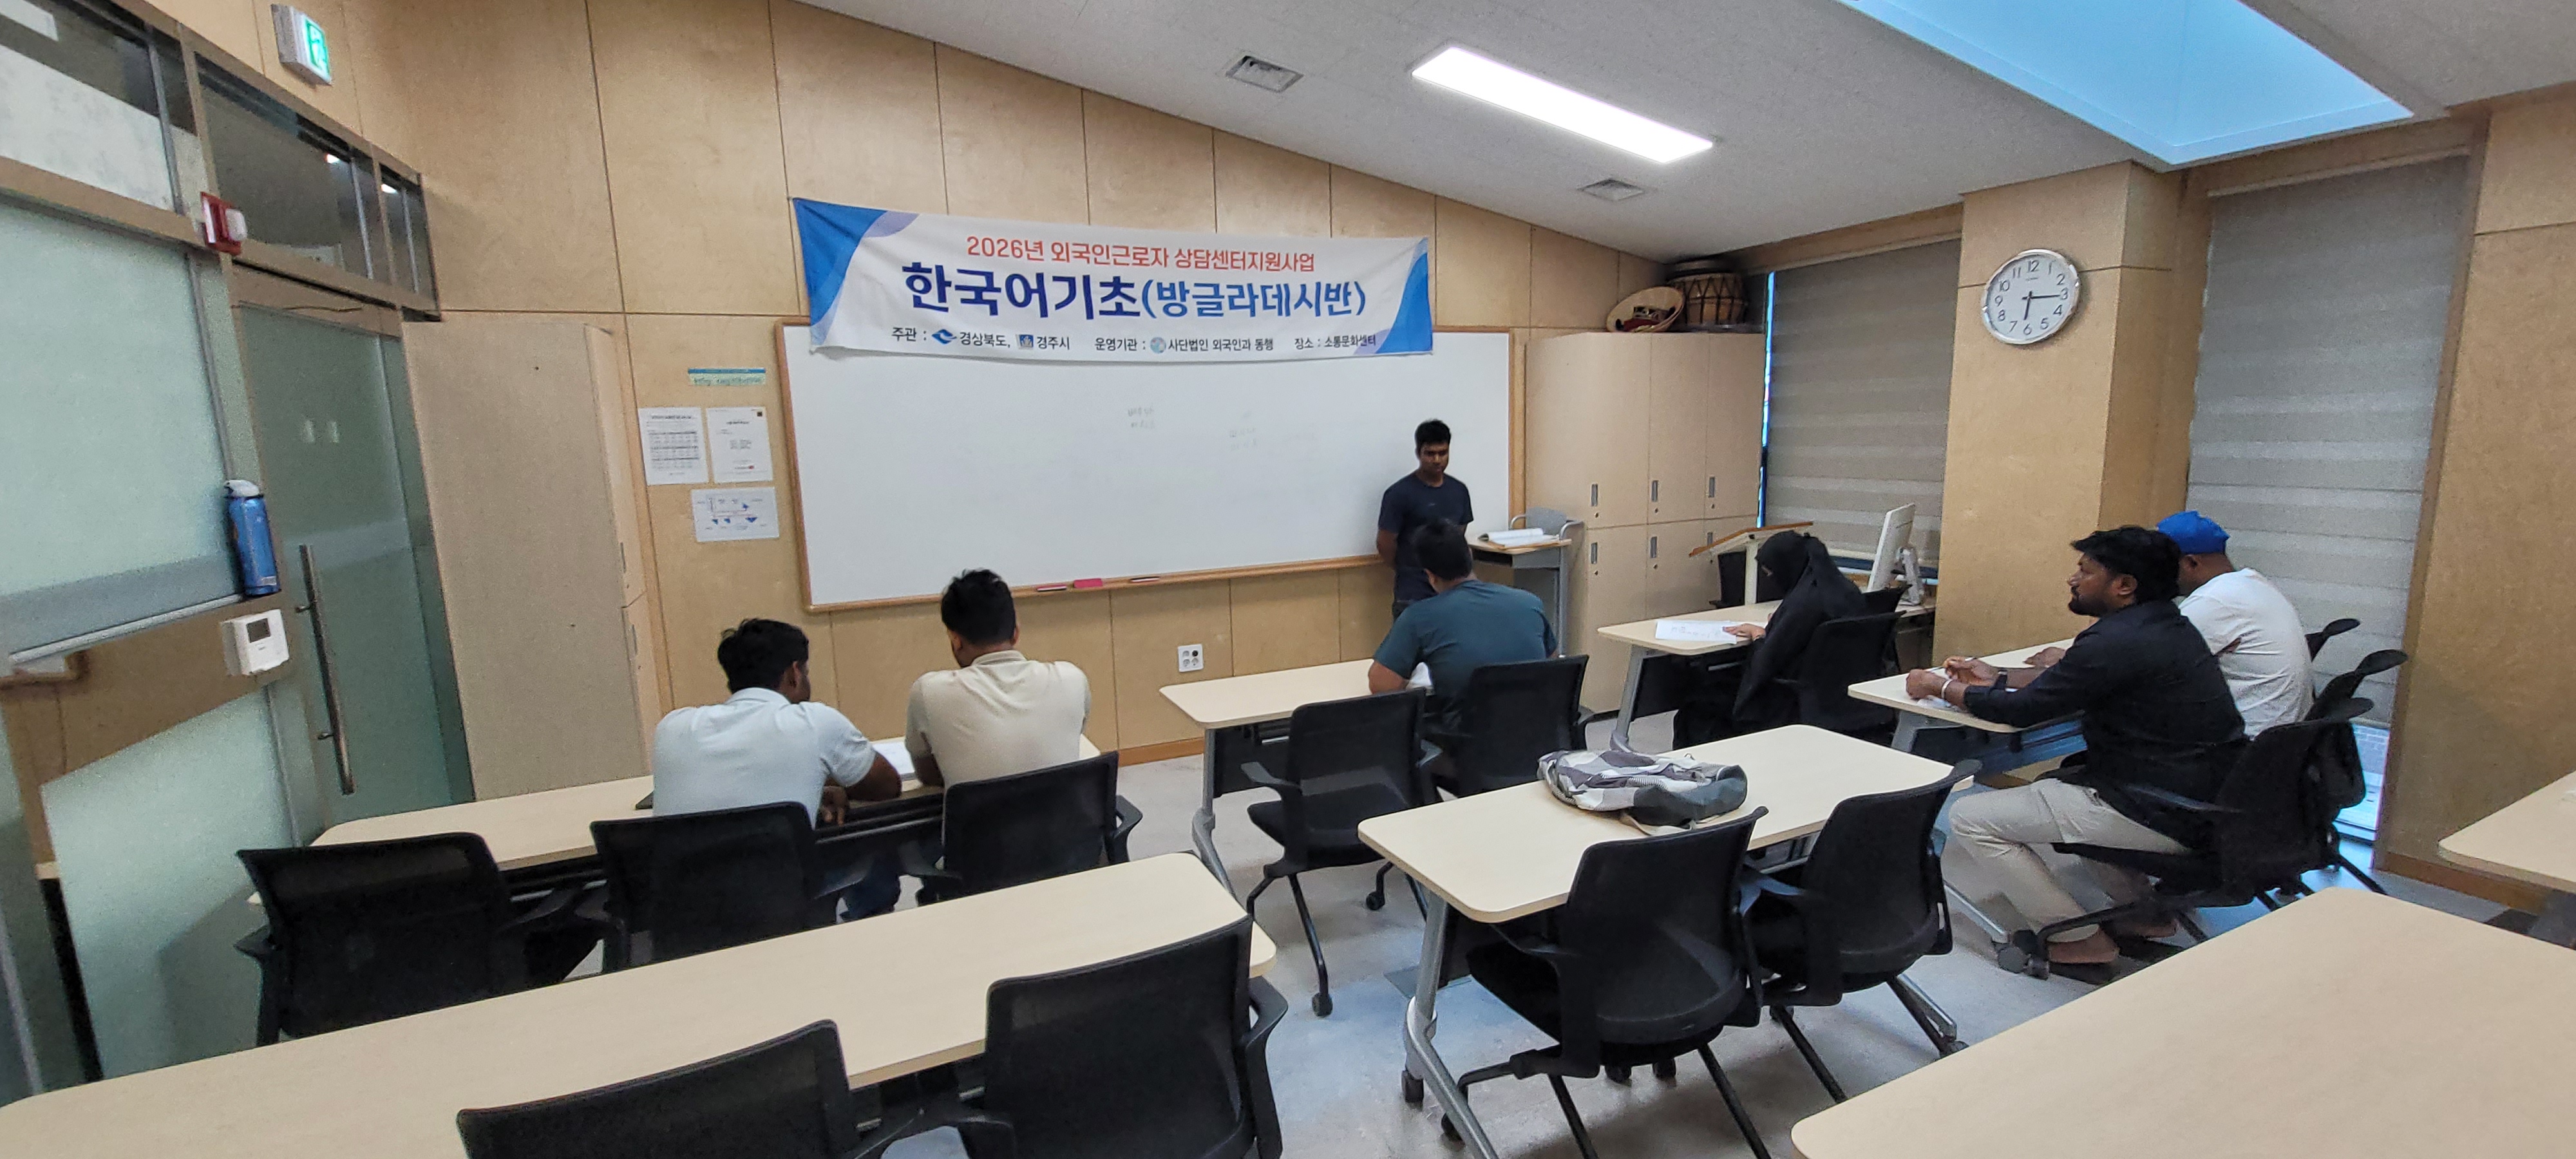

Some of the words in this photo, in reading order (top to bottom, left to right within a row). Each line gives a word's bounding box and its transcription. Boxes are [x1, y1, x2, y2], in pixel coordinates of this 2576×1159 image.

[967, 236, 1045, 261] 2026년
[1051, 241, 1169, 269] 외국인근로자
[1174, 248, 1314, 272] 상담센터지원사업
[2027, 259, 2040, 272] 12
[2048, 261, 2053, 275] 1
[2012, 267, 2022, 278] 11
[1999, 279, 2010, 292] 10
[2056, 274, 2066, 285] 2
[902, 262, 1366, 321] 한국어기초(방글라데시반)
[2060, 288, 2069, 300] 3
[1994, 295, 2003, 306] 9
[1998, 309, 2005, 321] 8
[2053, 305, 2063, 316] 4
[2009, 321, 2018, 333] 7
[2023, 323, 2032, 335] 6
[2040, 317, 2049, 330] 5
[891, 327, 916, 342] 주관
[960, 332, 1010, 348] 경상북도,
[1036, 336, 1070, 350] 경주시
[1095, 337, 1137, 352] 운영기관
[1168, 338, 1208, 352] 사단법인
[1212, 339, 1251, 352] 외국인과
[1255, 338, 1273, 352] 동행
[1294, 337, 1313, 350] 장소
[1324, 334, 1376, 348] 소통문화센터
